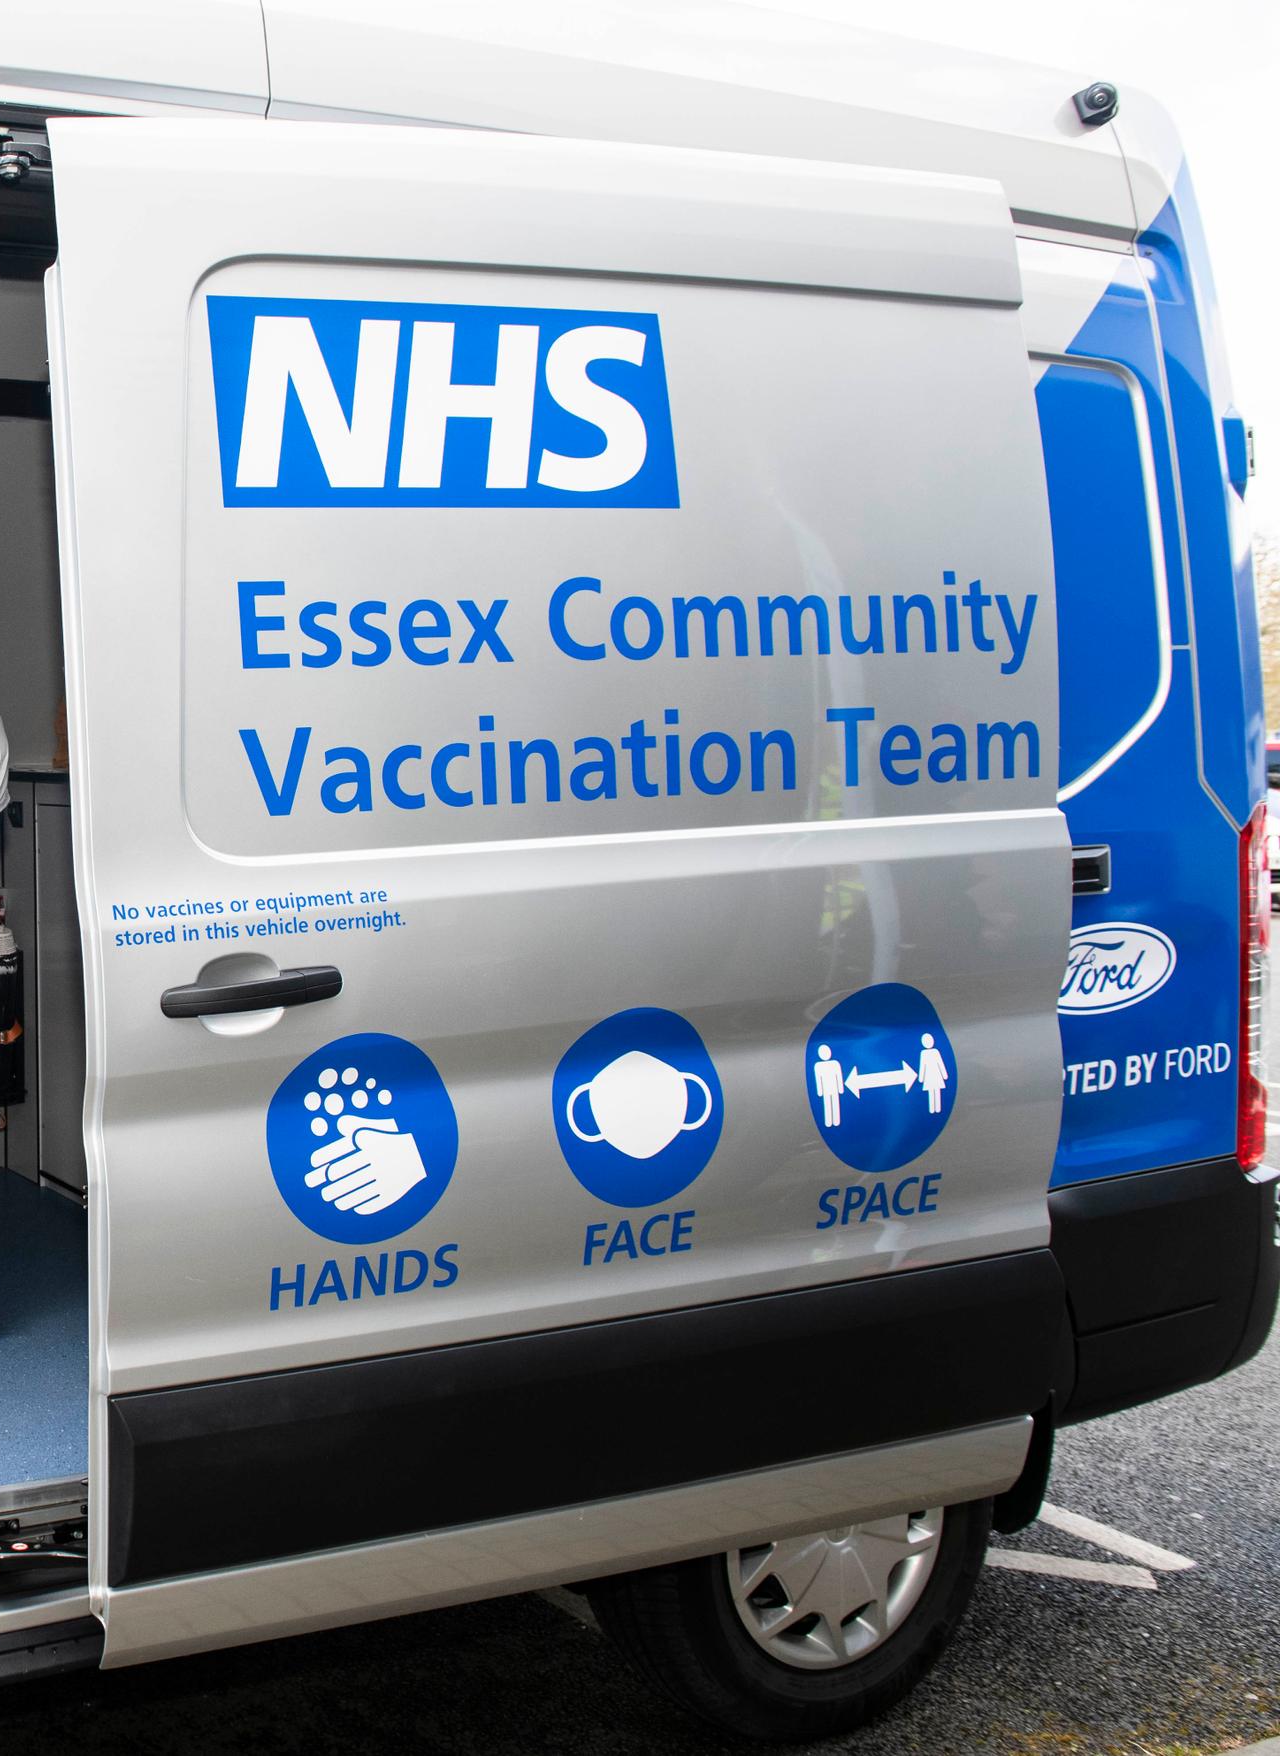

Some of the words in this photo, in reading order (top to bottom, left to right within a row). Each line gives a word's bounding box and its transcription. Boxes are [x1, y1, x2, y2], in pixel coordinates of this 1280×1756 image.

[235, 315, 647, 492] NHS
[236, 578, 516, 671] Essex
[547, 568, 1040, 677] Community
[238, 706, 798, 817] Vaccination
[824, 705, 1041, 789] Team
[111, 904, 141, 921] No
[146, 899, 224, 919] vaccines
[230, 900, 249, 913] or
[255, 889, 354, 914] equipment
[360, 889, 388, 904] are
[115, 924, 177, 947] stored
[182, 925, 200, 942] in
[205, 922, 240, 941] this
[245, 916, 309, 938] vehicle
[314, 910, 407, 933] overnight.
[1060, 940, 1145, 998] Ford
[1062, 1058, 1117, 1097] TED
[1124, 1052, 1158, 1087] BY
[1164, 1042, 1231, 1080] FORD
[815, 1172, 942, 1231] SPACE
[582, 1209, 697, 1266] FACE
[269, 1242, 460, 1313] HANDS
